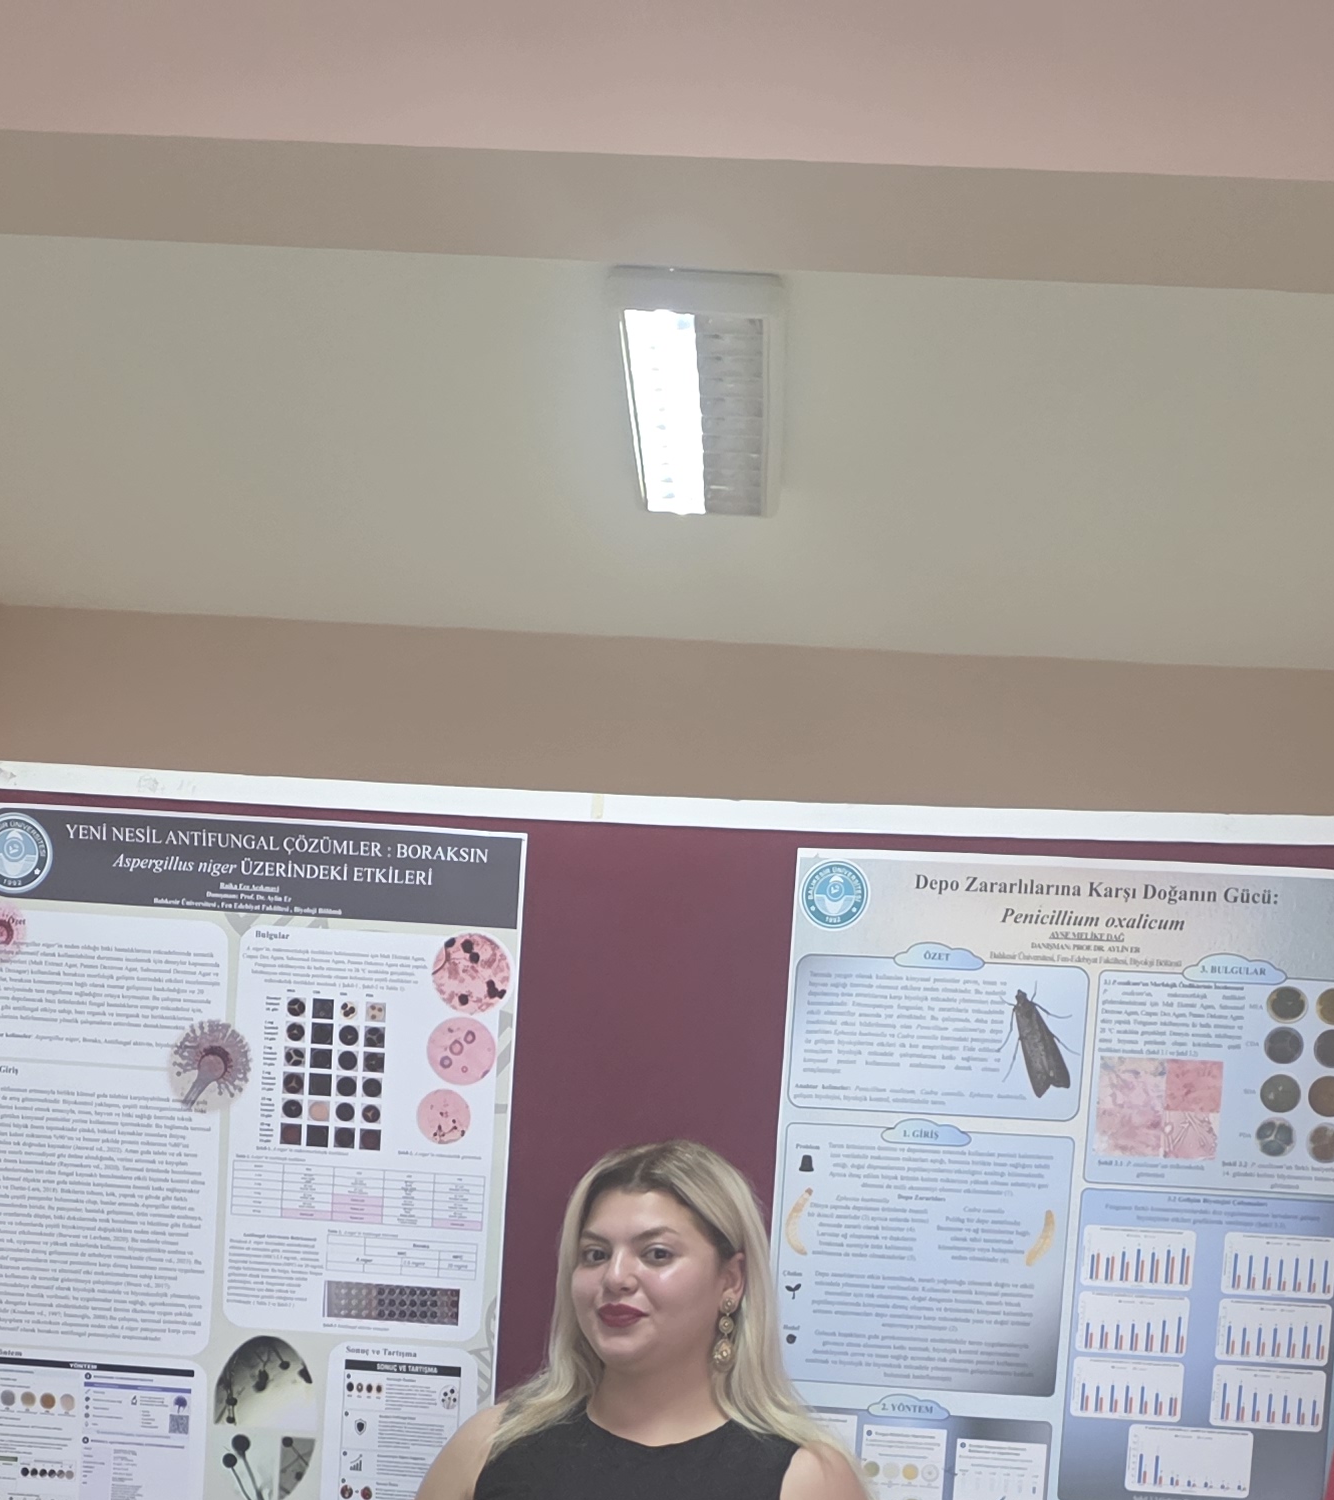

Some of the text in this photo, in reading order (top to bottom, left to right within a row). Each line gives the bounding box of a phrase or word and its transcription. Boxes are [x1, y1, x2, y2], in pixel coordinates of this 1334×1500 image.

[66, 823, 107, 841] YENİ
[112, 825, 162, 844] NESİL
[165, 828, 280, 851] ANTİFUNGAL
[283, 835, 382, 858] ÇÖZÜMLER
[397, 844, 489, 863] BORAKSIN
[112, 854, 433, 886] Aspergillus niger ÜZERİNDEKİ ETKİLERİ
[915, 874, 1279, 905] Depo Zararlılarına Karşı Doğanın Gücü:
[1001, 908, 1186, 931] Penicillium oxalicum
[255, 930, 290, 941] Bulgular
[923, 951, 951, 961] ÖZET
[1200, 965, 1266, 976] 3. BULGULAR
[0, 1065, 19, 1075] Giriş
[912, 1130, 939, 1140] GİRİŞ
[345, 1345, 369, 1356] Sonuç
[382, 1348, 417, 1358] Tartışma
[891, 1403, 934, 1414] YÖNTEM
